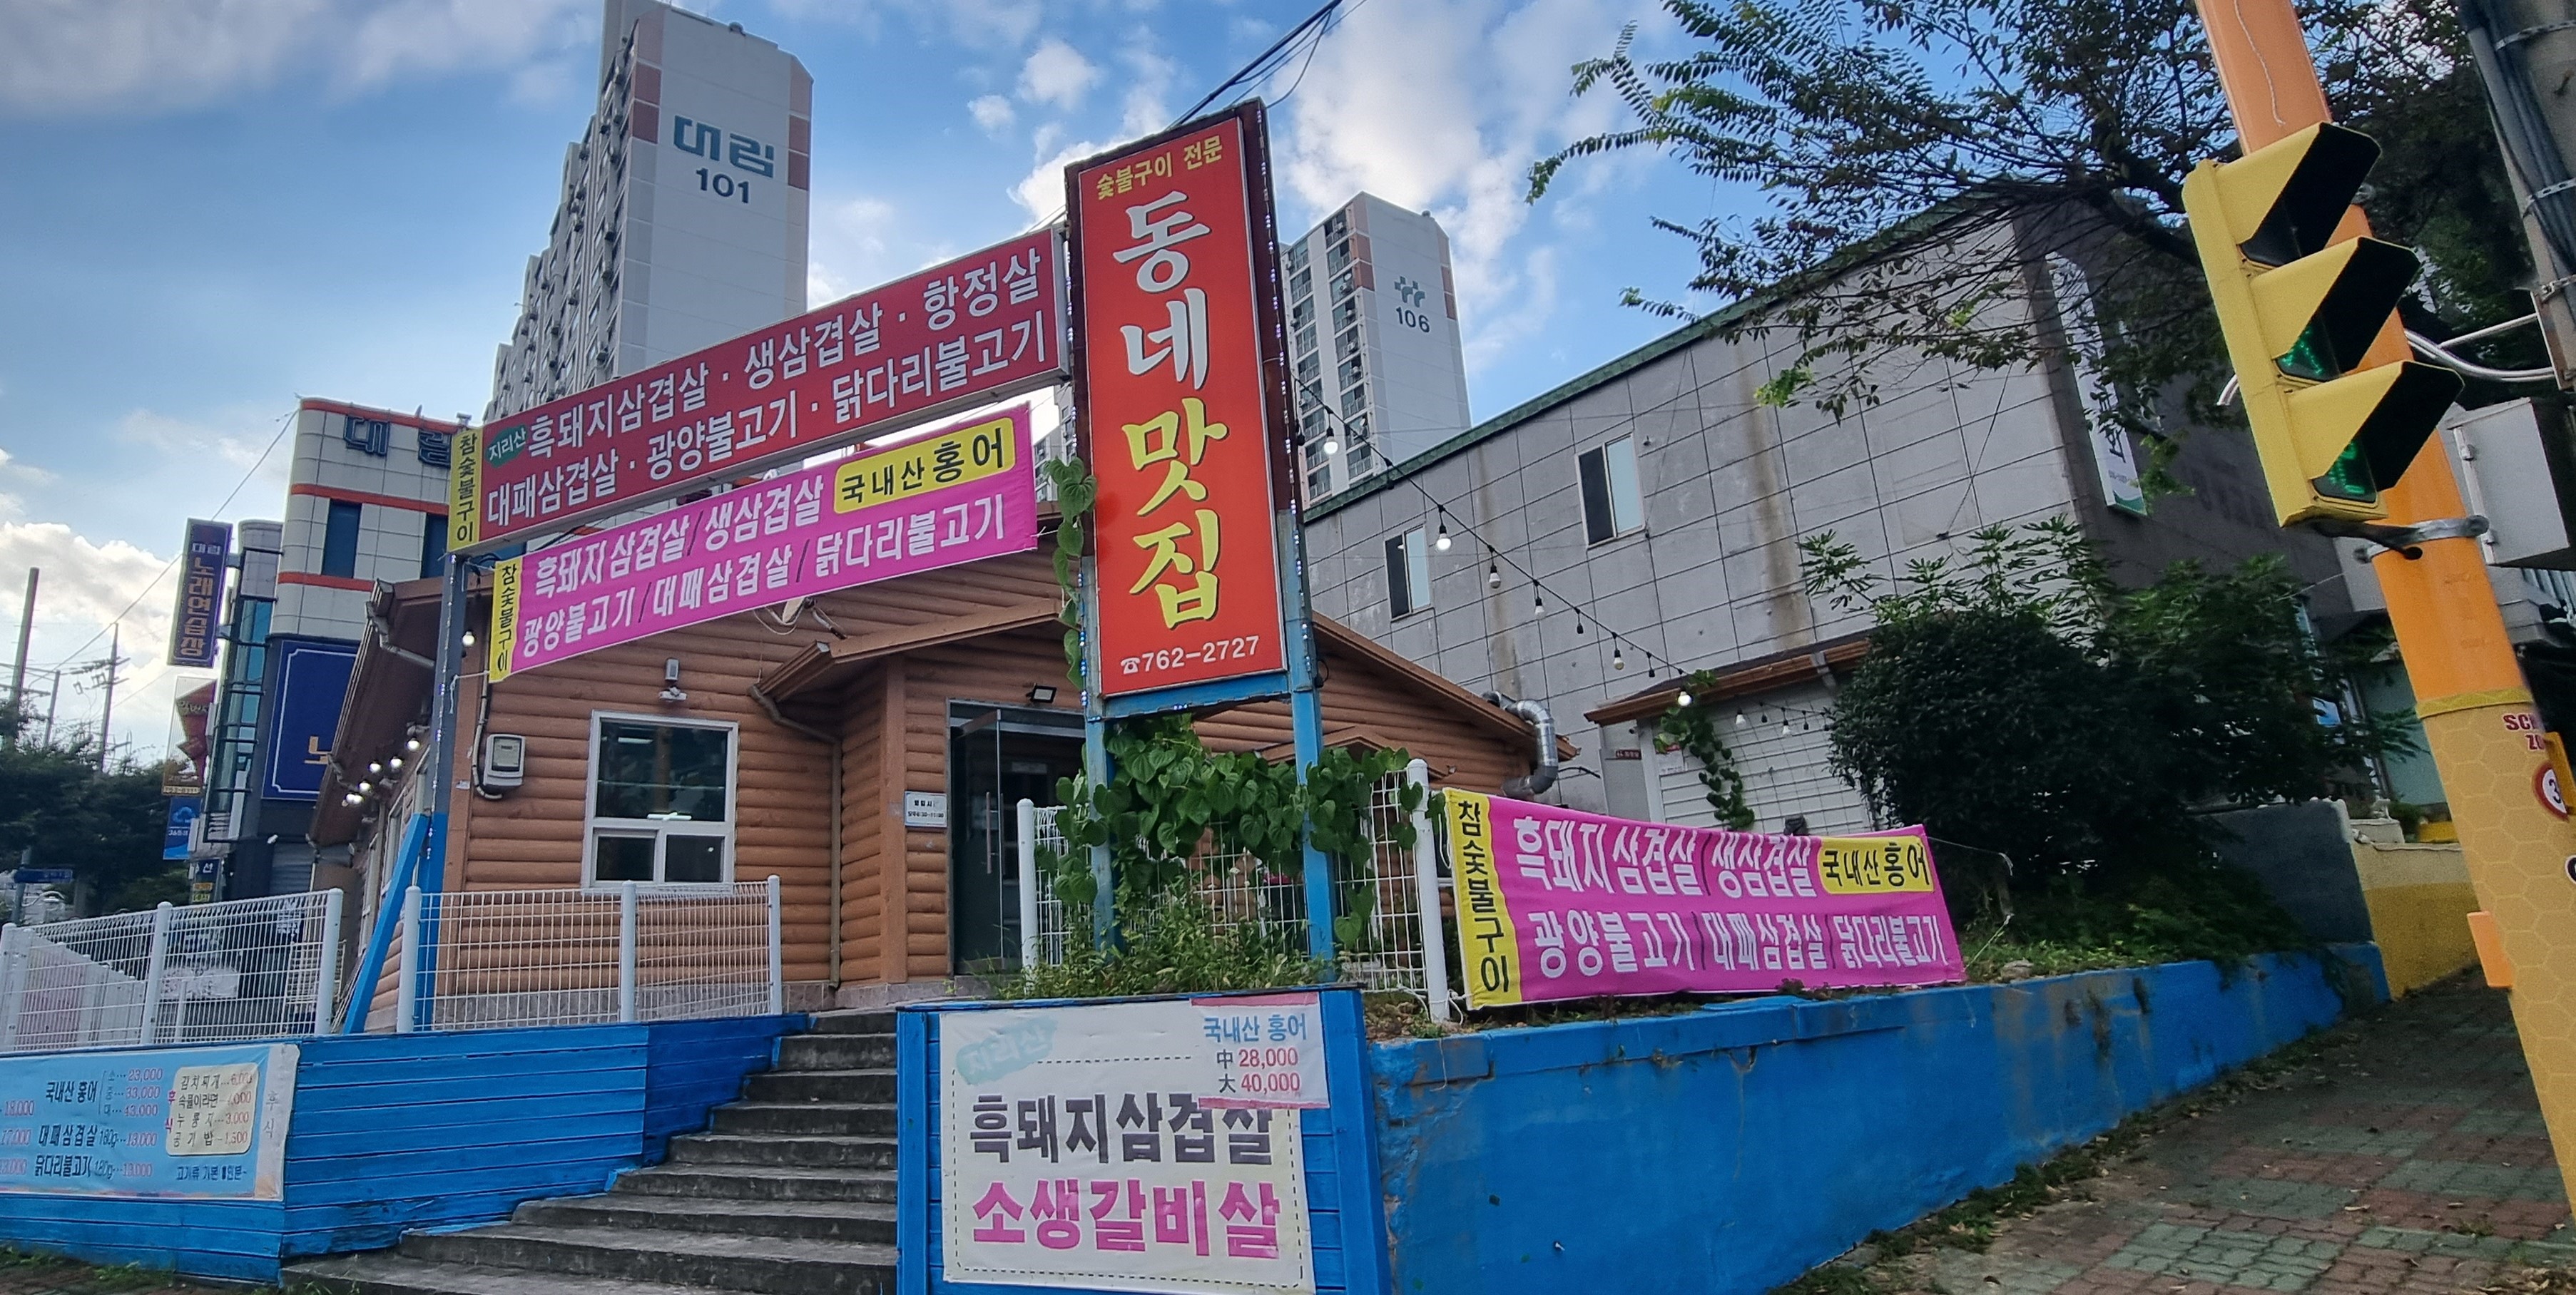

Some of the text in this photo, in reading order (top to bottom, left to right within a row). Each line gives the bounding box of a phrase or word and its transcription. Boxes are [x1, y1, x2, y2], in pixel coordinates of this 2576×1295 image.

[674, 115, 774, 178] 대림
[1096, 135, 1223, 200] 숯불구이 전문
[696, 168, 749, 203] 101
[527, 247, 1042, 457] 흑돼지삼겹살 생삼겹살 항정살
[1396, 307, 1430, 333] 106
[487, 310, 1046, 528] 대패삼겹살 광양불고기 닭다리불고기
[488, 429, 526, 461] 지리산
[456, 433, 478, 543] 참숯불구이
[703, 474, 825, 553] 생삼겹살
[522, 493, 1005, 659] 광양불고기 대패삼겹살 닭다리불고기
[494, 562, 518, 672] 참숯불구이
[1142, 635, 1259, 672] 762-2727
[1457, 799, 1510, 993] 참숯불구이
[1711, 831, 1818, 900] 생삼겹살
[1527, 910, 1950, 979] 광양불고기 대패삼겹살 닭다리불고기
[1203, 1013, 1307, 1043] 국내산 홍어
[1217, 1047, 1299, 1070] 中 28,000
[1218, 1072, 1300, 1095] 大 40,000
[969, 1092, 1273, 1166] 흑돼지삼겹살
[973, 1178, 1281, 1259] 소생갈비살
